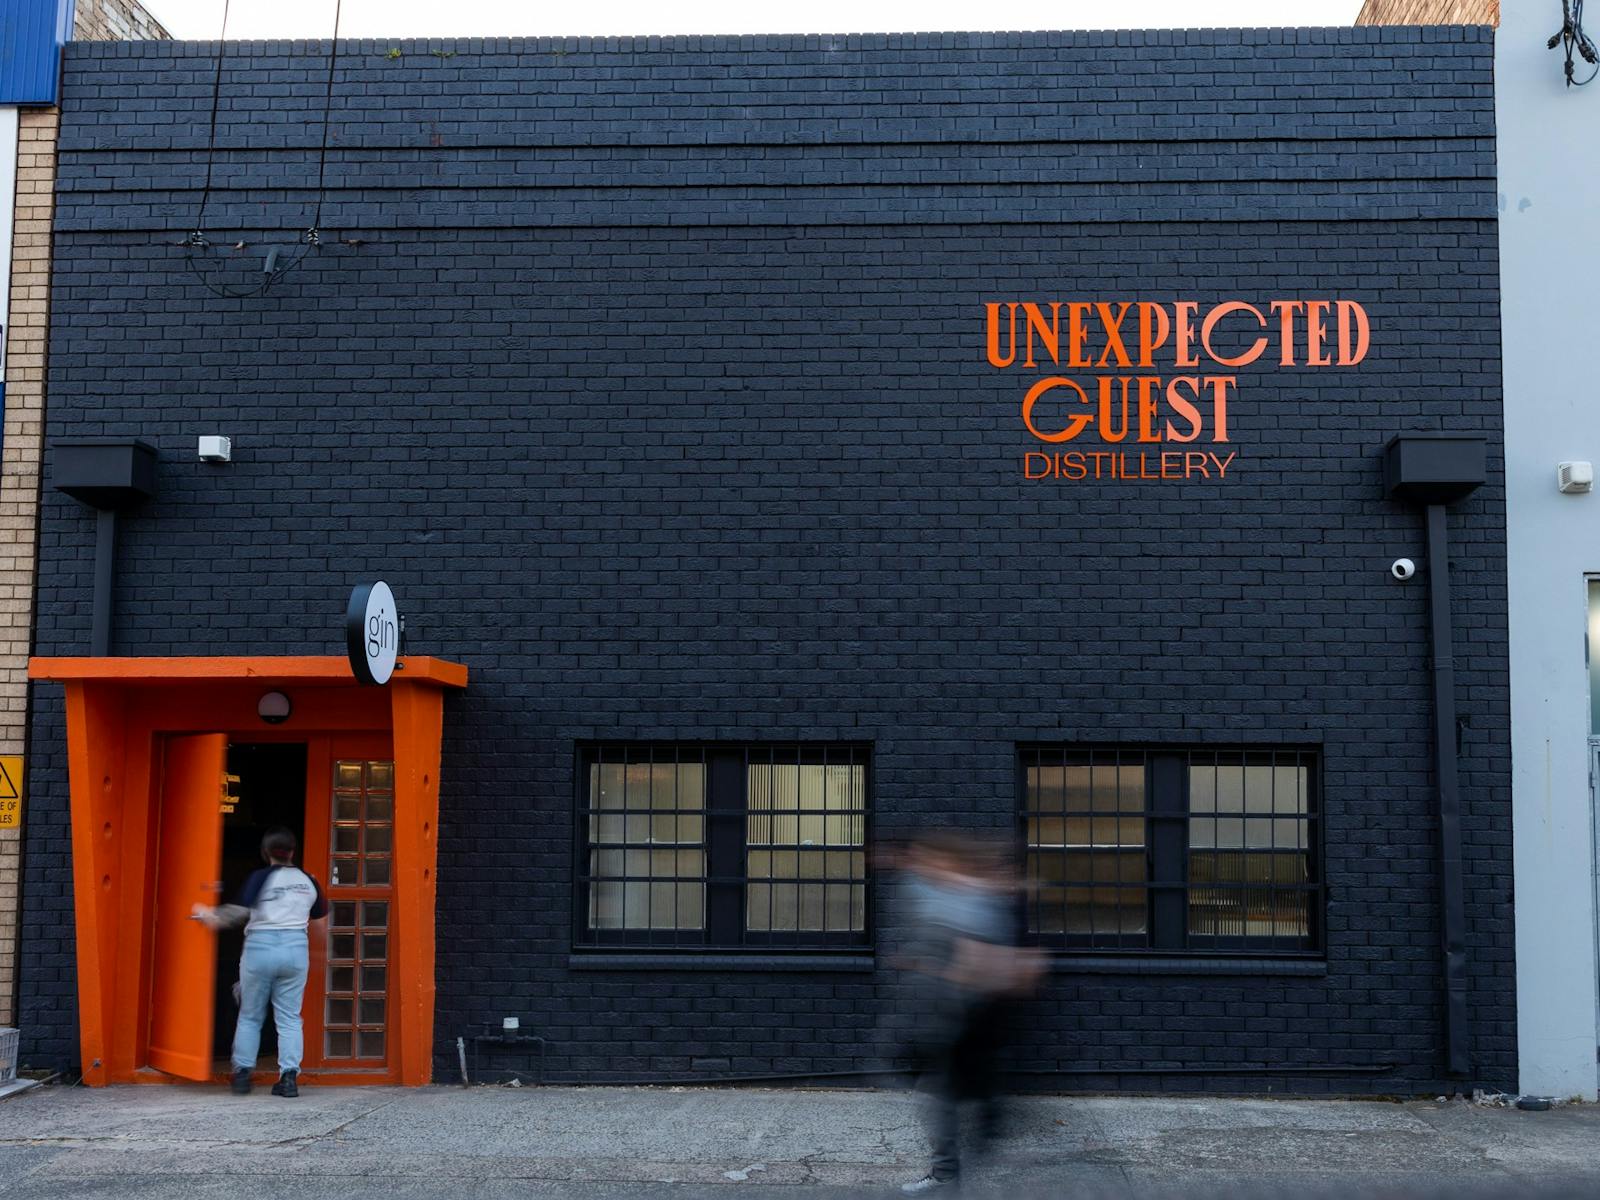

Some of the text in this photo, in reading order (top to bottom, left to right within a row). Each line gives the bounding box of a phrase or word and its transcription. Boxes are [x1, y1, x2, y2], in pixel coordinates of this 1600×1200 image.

[985, 300, 1371, 368] UNEXPECTED
[1022, 376, 1237, 443] GUEST
[1024, 452, 1236, 480] DISTILLERY
[368, 608, 395, 658] gin
[7, 801, 17, 811] OF
